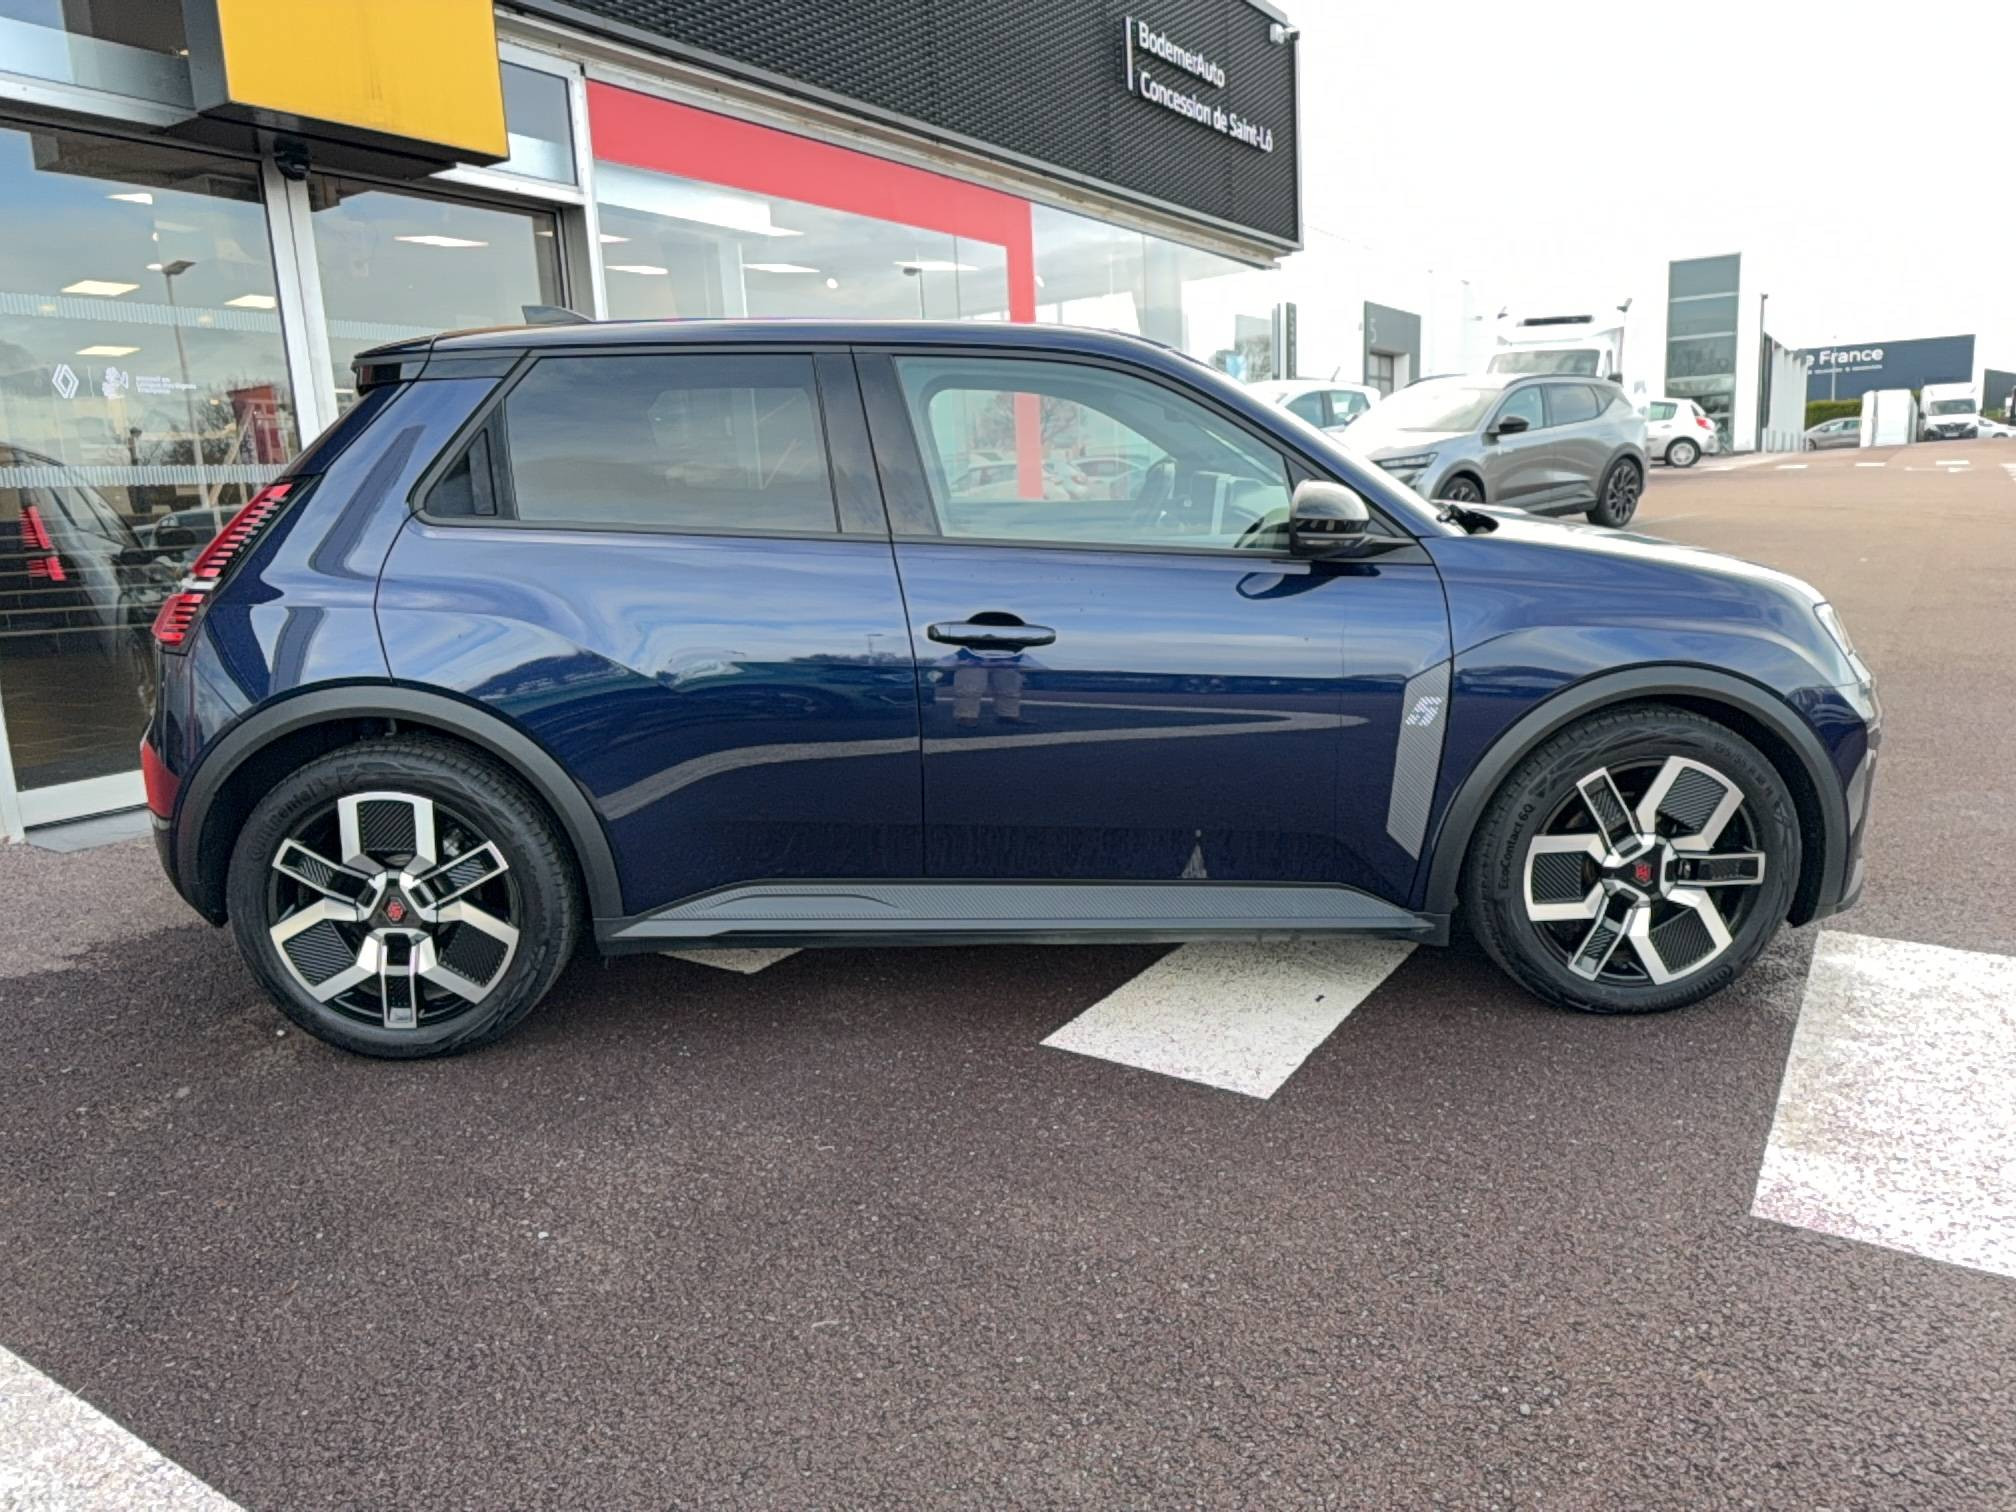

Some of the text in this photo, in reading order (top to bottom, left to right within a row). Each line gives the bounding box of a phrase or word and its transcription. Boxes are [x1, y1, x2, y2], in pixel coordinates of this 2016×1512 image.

[1138, 21, 1225, 88] BodemerAuto
[1140, 71, 1273, 152] Concession de Saint-Lô
[1819, 348, 1884, 365] France
